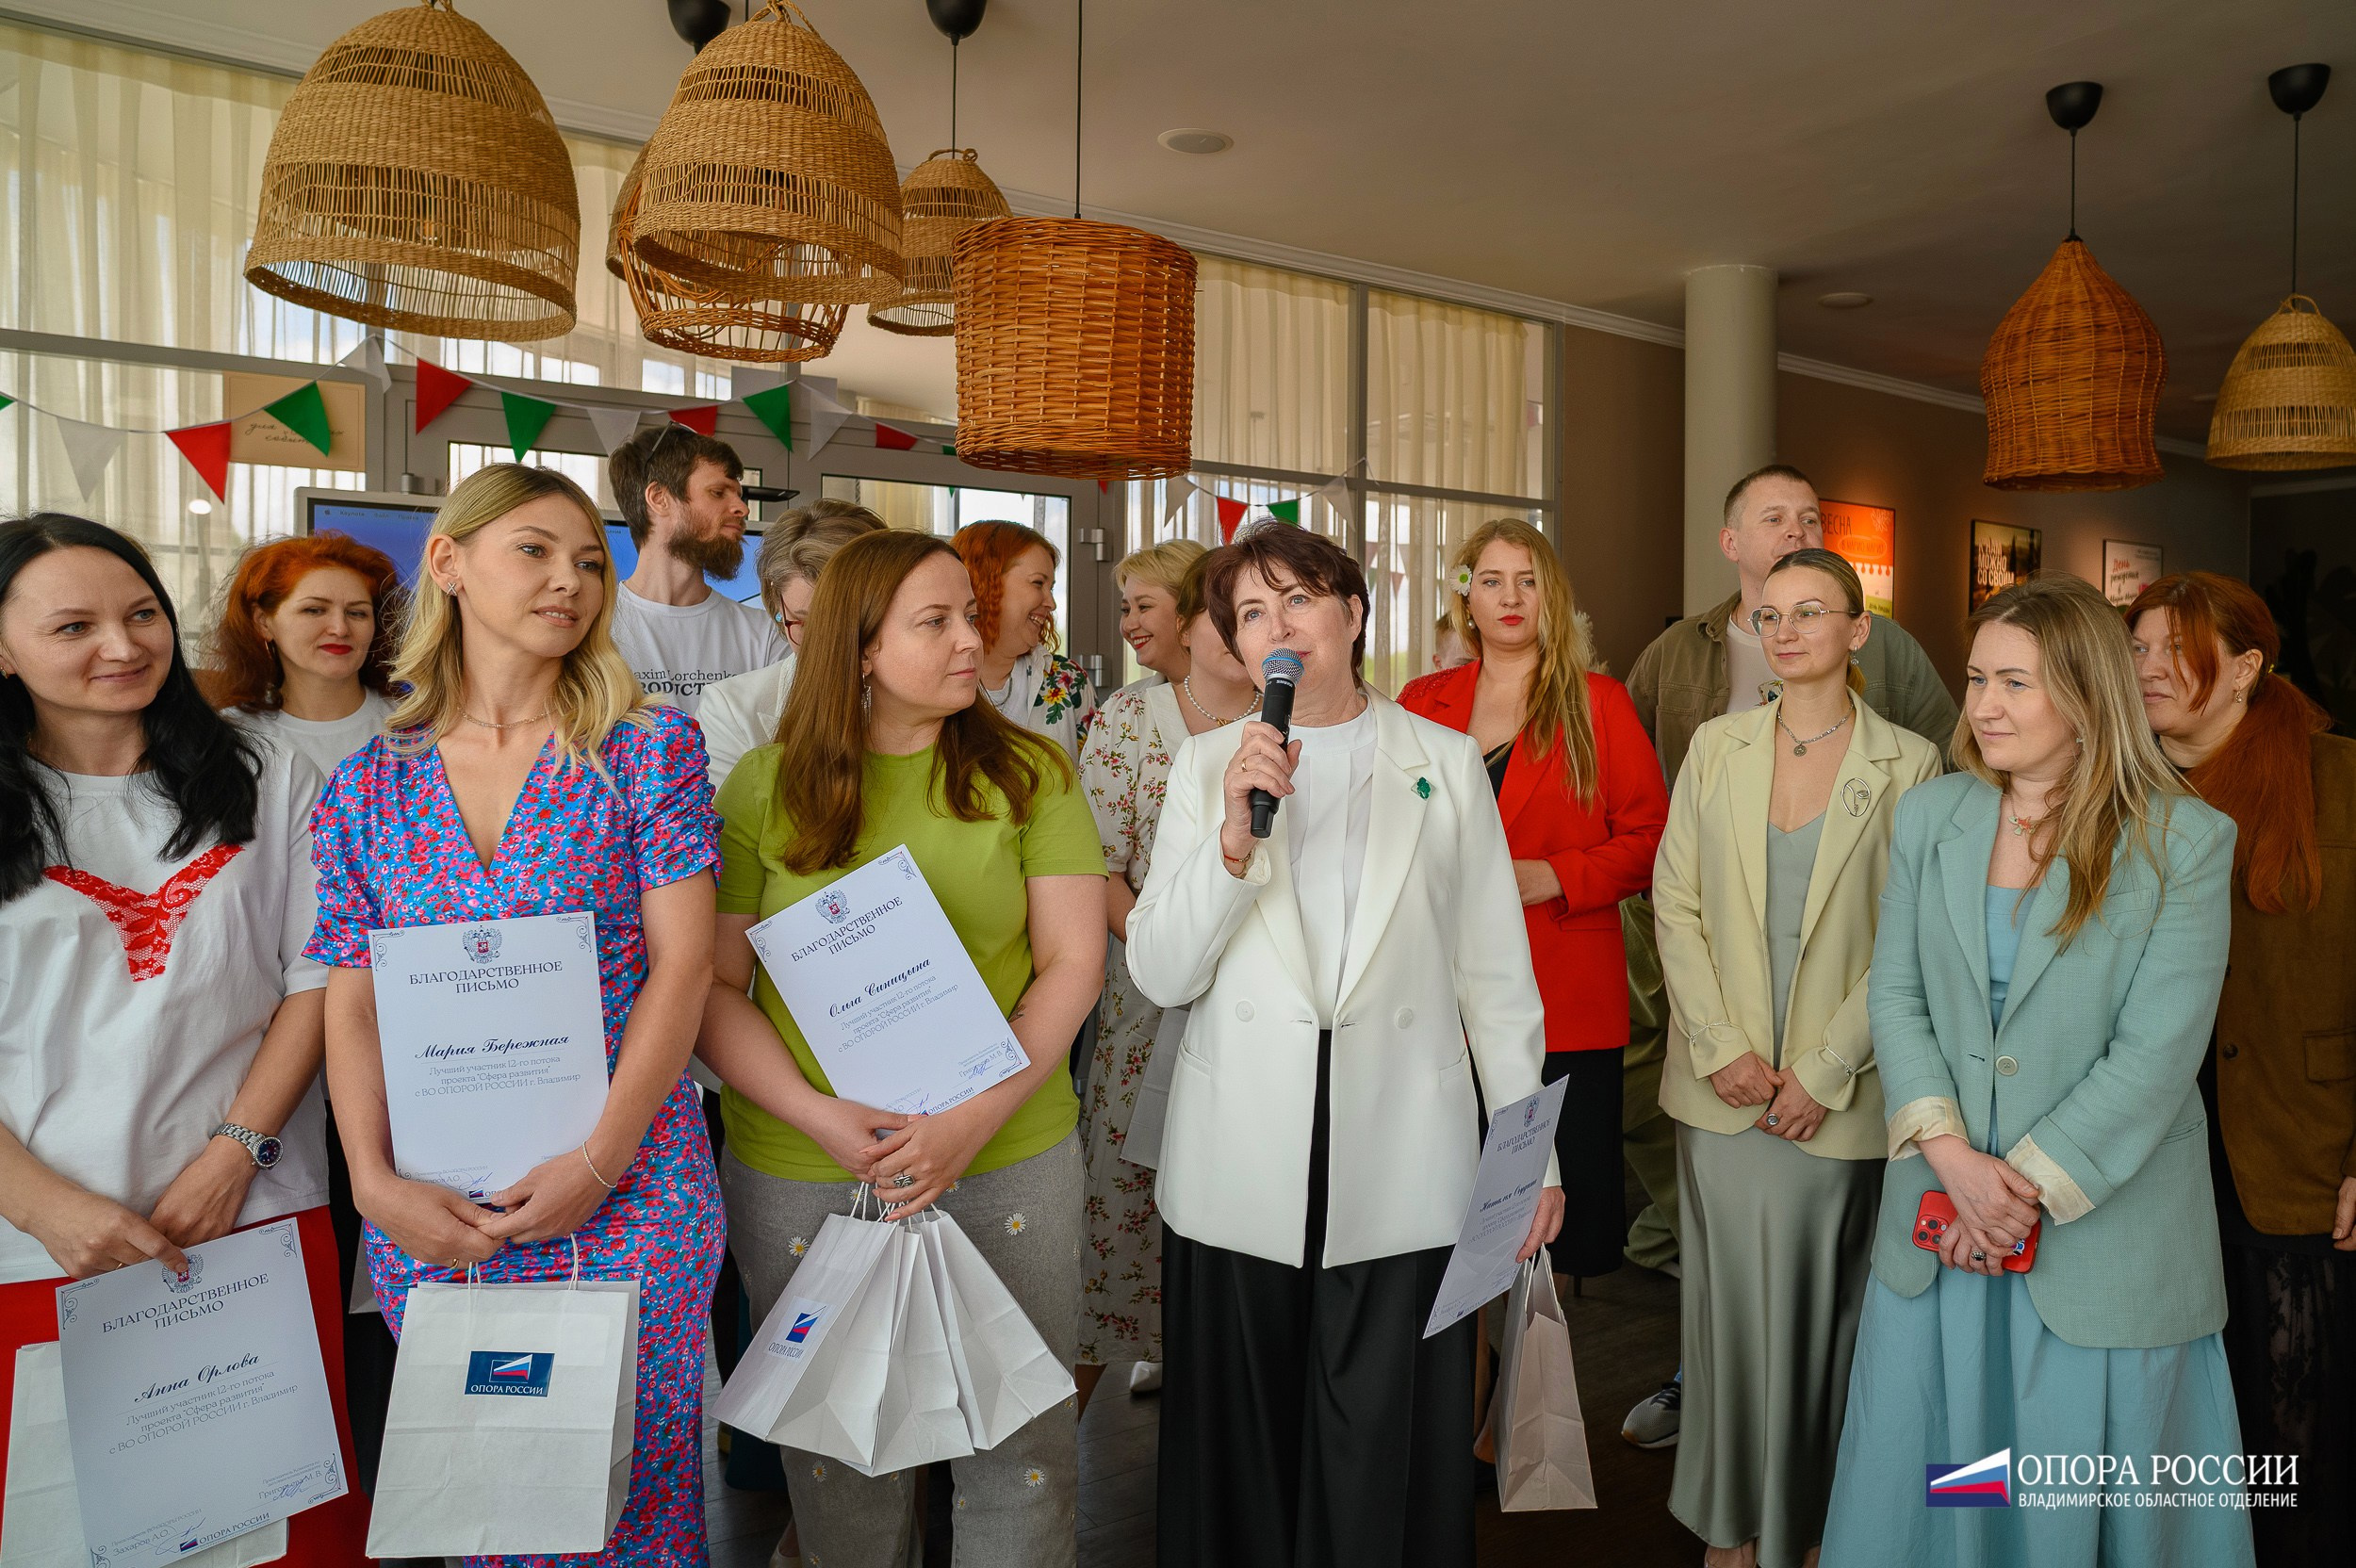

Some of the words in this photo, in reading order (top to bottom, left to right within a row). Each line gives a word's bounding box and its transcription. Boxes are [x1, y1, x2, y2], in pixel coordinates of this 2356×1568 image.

[1821, 513, 1852, 535] ВЕСНА
[1978, 554, 2007, 572] МОЖНО
[1978, 569, 1988, 585] СО
[1988, 570, 2015, 587] СВОИМ
[633, 668, 667, 679] axim
[792, 896, 903, 962] БЛАГОДАРСТВЕННОЕ
[828, 924, 875, 955] ПИСЬМО
[409, 960, 563, 985] БЛАГОДАРСТВЕННОЕ
[456, 978, 519, 993] ПИСЬМО
[829, 996, 862, 1018] Ольга
[864, 958, 930, 996] Синицына
[841, 1013, 868, 1031] Лучший
[868, 997, 897, 1018] участник
[896, 988, 913, 1000] 12-го
[913, 975, 937, 991] потока
[888, 1004, 921, 1025] РОССИИ
[924, 984, 958, 1005] Владимир
[853, 1018, 879, 1035] проекта
[415, 1043, 476, 1059] Мария
[482, 1037, 569, 1056] Бережная
[430, 1065, 466, 1076] Лучший
[466, 1062, 507, 1074] участник
[507, 1058, 529, 1068] 12-го
[531, 1056, 561, 1066] потока
[421, 1088, 436, 1097] ВО
[437, 1083, 483, 1095] ОПОРОЙ
[484, 1079, 528, 1091] РОССИИ
[537, 1072, 581, 1086] Владимир
[441, 1075, 476, 1086] проекта
[928, 1101, 949, 1115] ОПОРА
[948, 1086, 974, 1103] РОССИИ
[103, 1273, 269, 1333] БЛАГОДАРСТВЕННОЕ
[155, 1299, 224, 1330] ПИСЬМО
[134, 1378, 189, 1403] Анна
[197, 1352, 260, 1383] Орлова
[470, 1384, 503, 1393] ОПОРА
[505, 1385, 543, 1395] РОССИИ
[126, 1405, 169, 1426] Лучший
[170, 1390, 217, 1413] участник
[217, 1382, 241, 1396] 12-го
[242, 1371, 275, 1387] потока
[118, 1439, 136, 1452] ВО
[137, 1418, 190, 1445] ОПОРОЙ
[193, 1402, 241, 1426] РОССИИ
[252, 1384, 298, 1405] Владимир
[141, 1414, 182, 1432] проекта
[199, 1527, 232, 1544] ОПОРА
[233, 1512, 270, 1531] РОССИИ
[113, 1538, 150, 1556] Захаров
